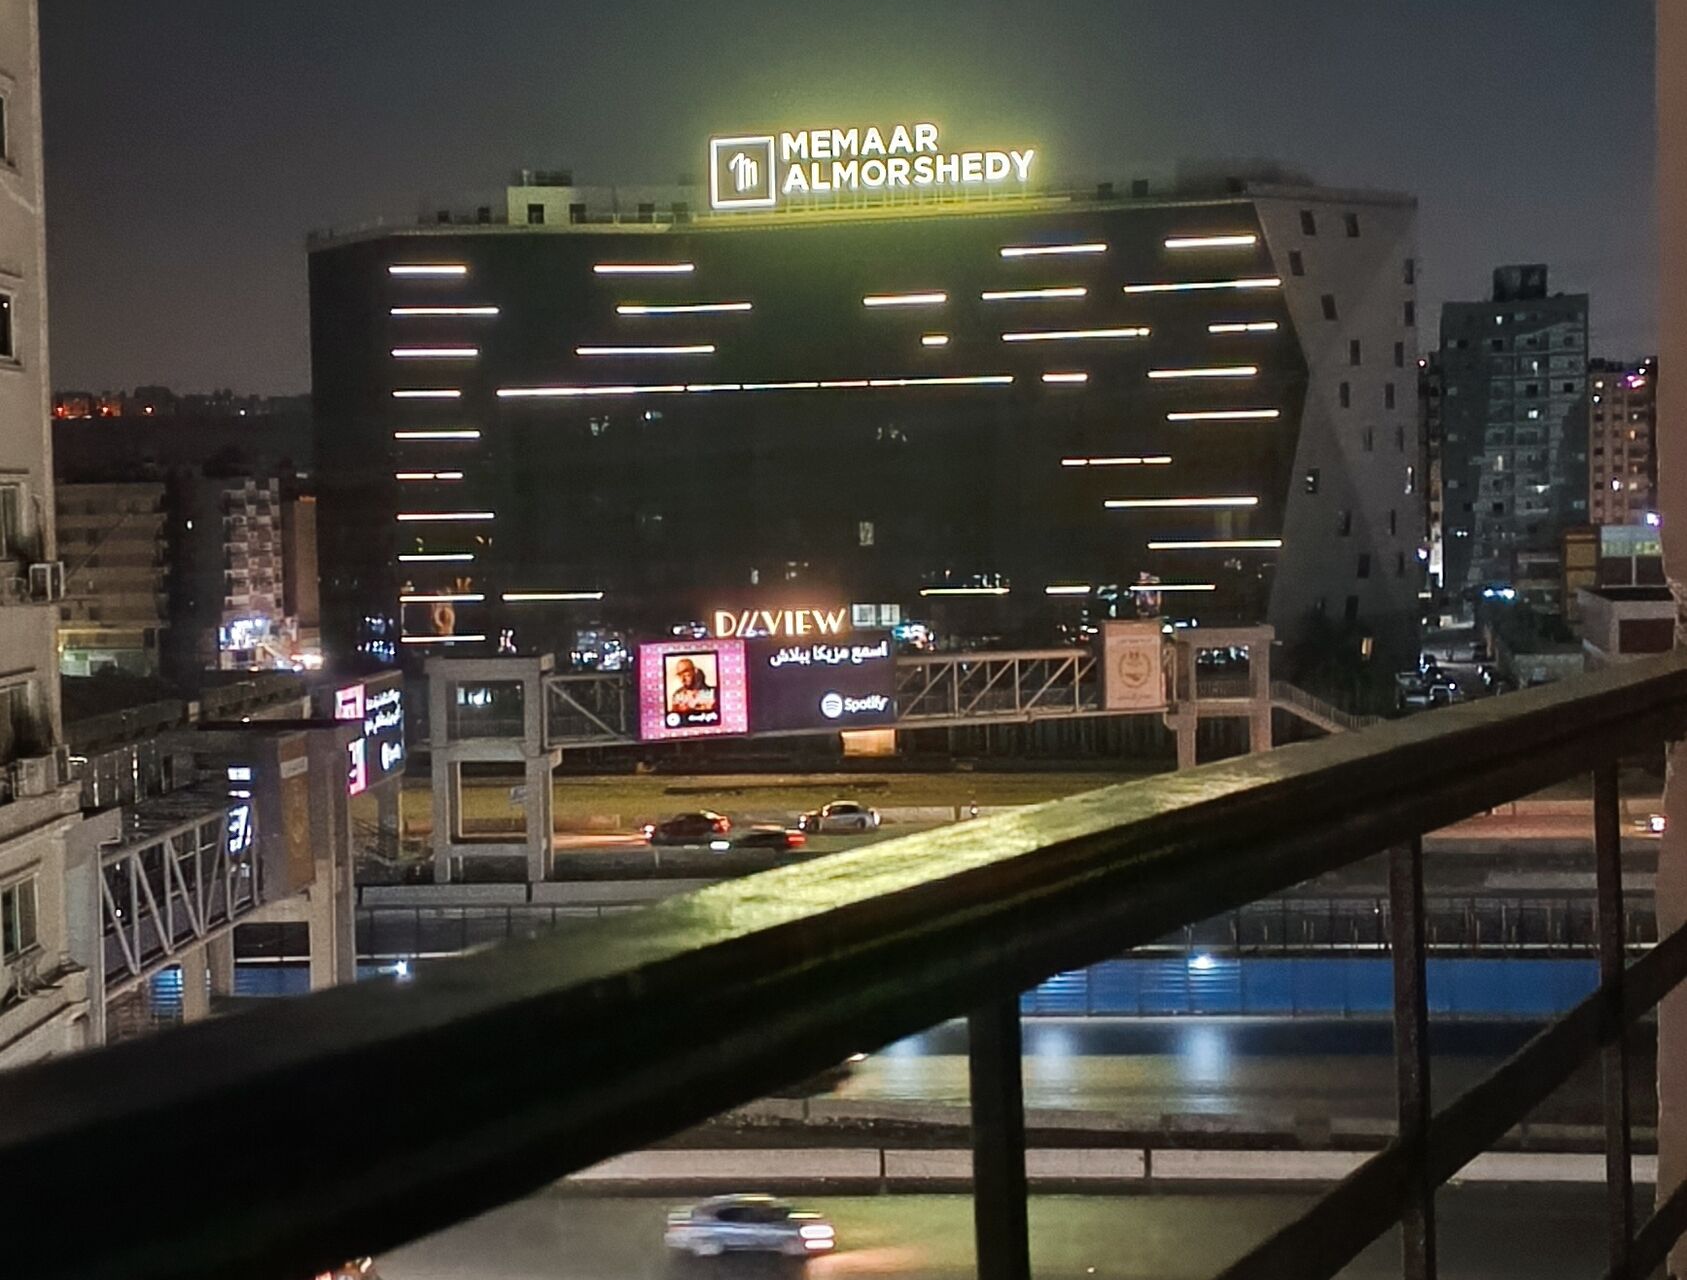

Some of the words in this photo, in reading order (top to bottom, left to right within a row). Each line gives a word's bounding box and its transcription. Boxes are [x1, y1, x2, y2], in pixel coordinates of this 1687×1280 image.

[782, 123, 938, 161] MEMAAR
[782, 149, 1035, 194] ALMORSHEDY
[844, 695, 889, 713] Spotify
